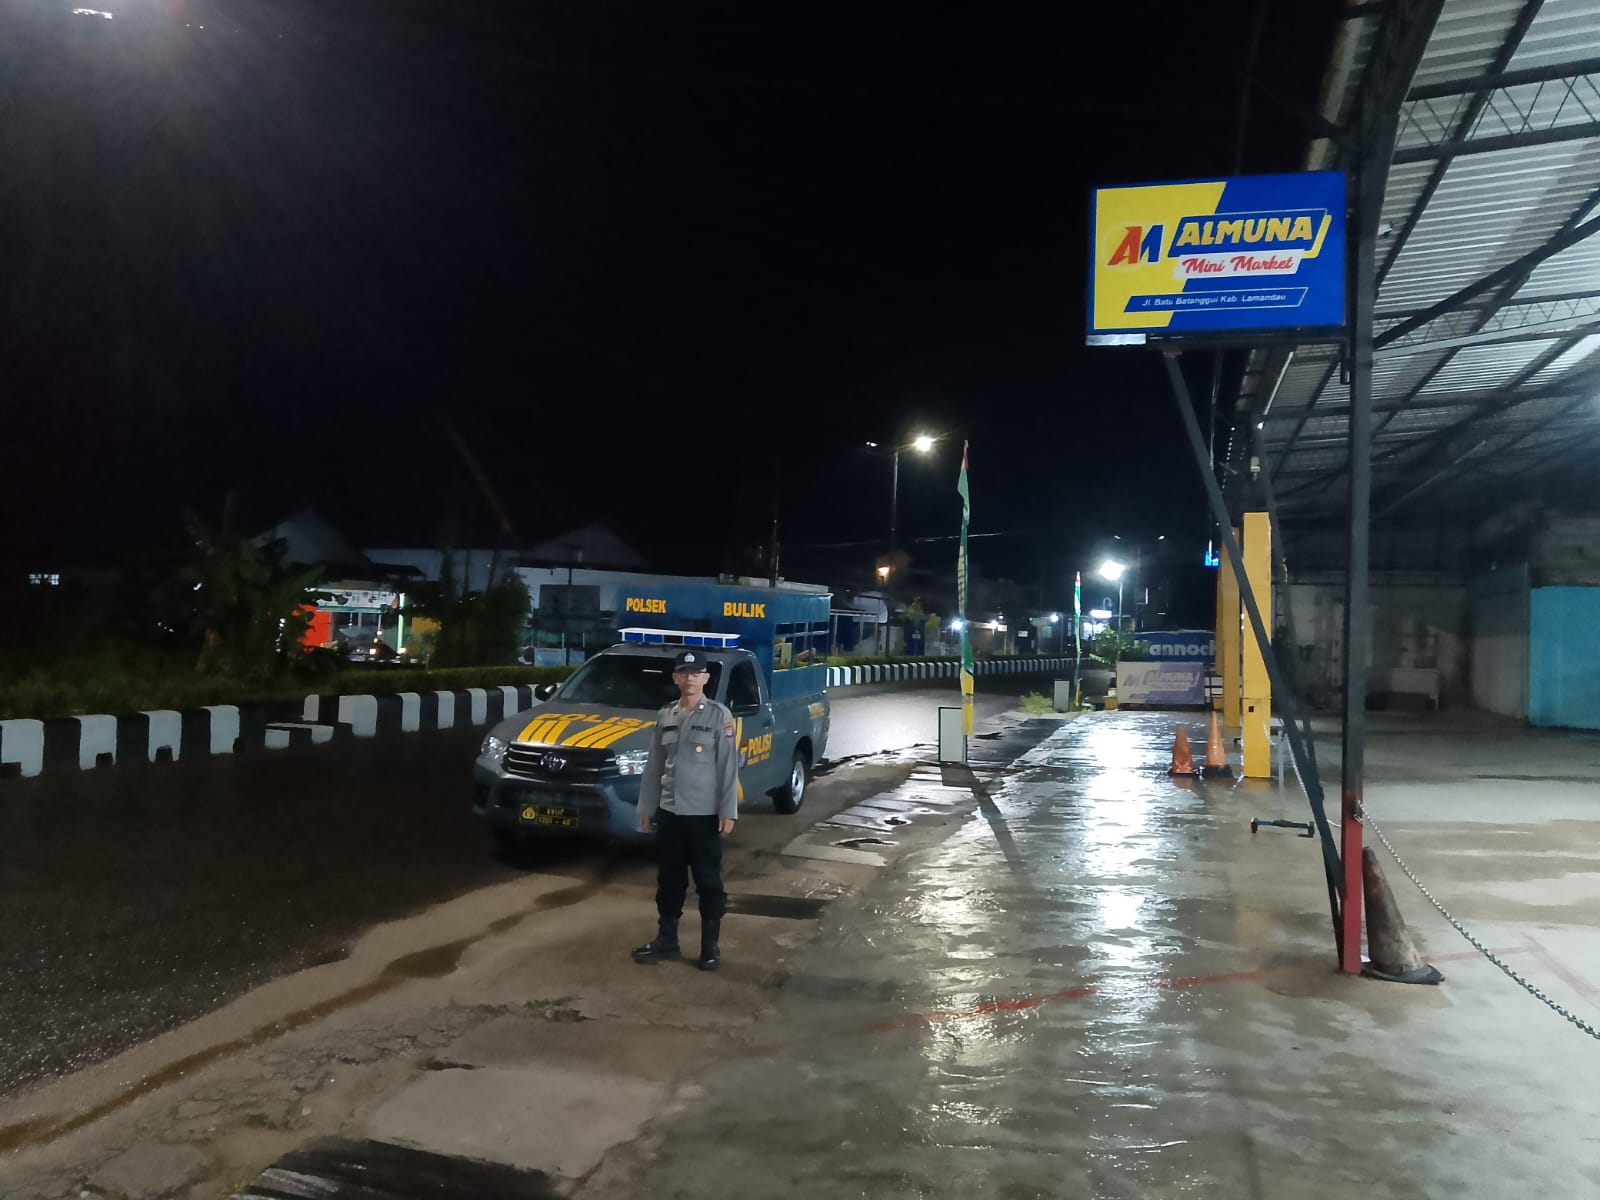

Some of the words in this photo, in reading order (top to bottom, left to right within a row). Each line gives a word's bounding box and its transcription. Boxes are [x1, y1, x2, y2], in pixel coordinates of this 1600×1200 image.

[1175, 216, 1313, 247] ALMUNA
[1182, 257, 1226, 275] Mini
[1230, 255, 1294, 273] Market
[1154, 298, 1174, 306] Batu
[1241, 293, 1287, 302] Lamandau
[626, 597, 667, 614] POLSEK
[723, 601, 766, 618] BULIK
[533, 713, 658, 729] POLISI
[748, 732, 772, 758] POLISI
